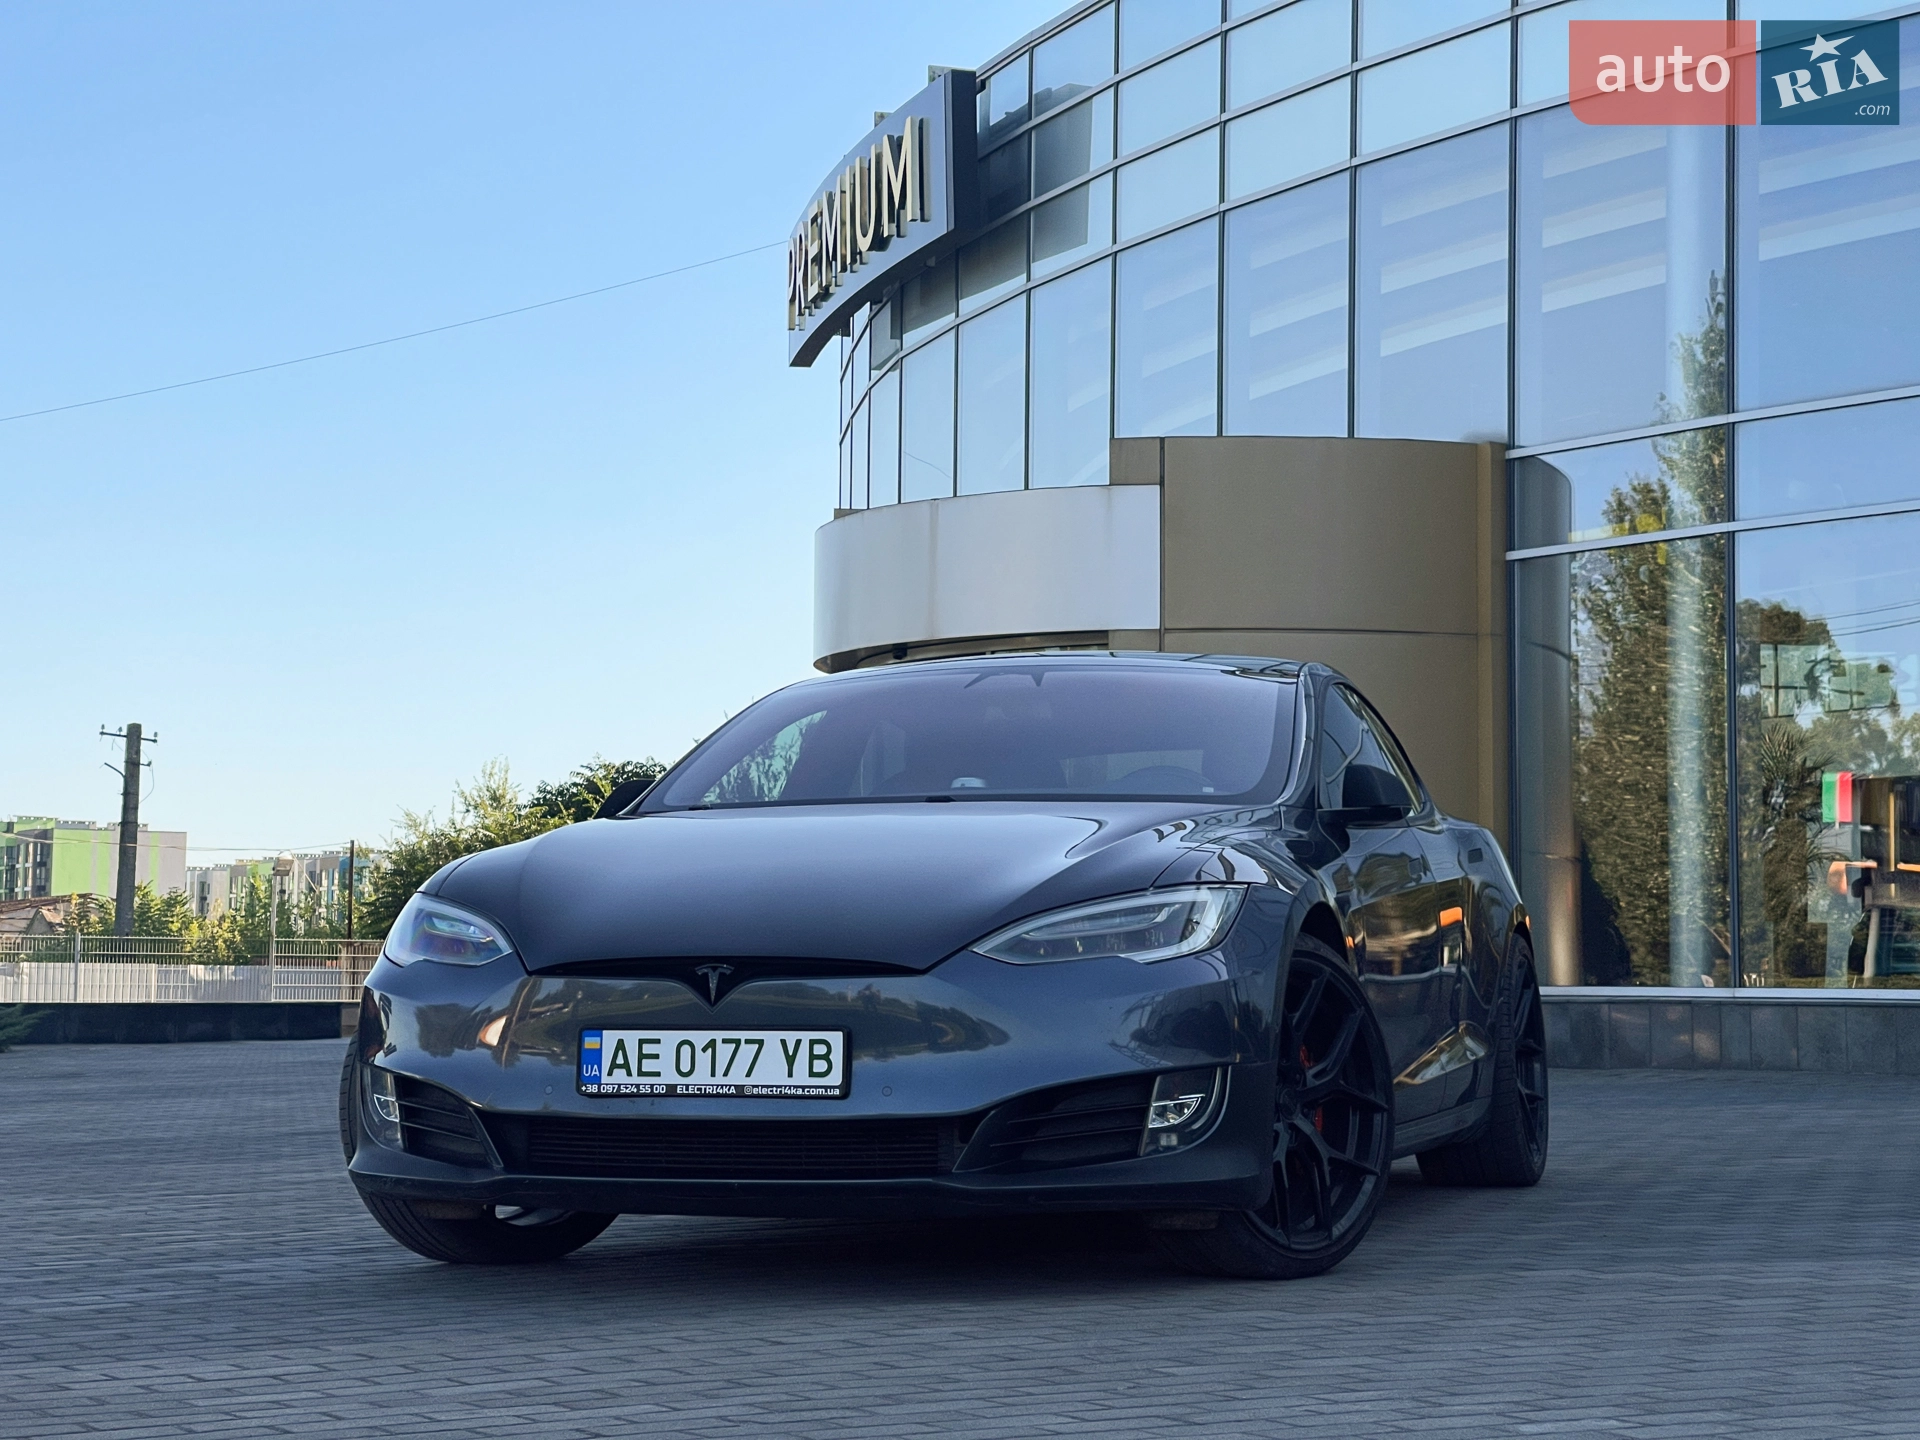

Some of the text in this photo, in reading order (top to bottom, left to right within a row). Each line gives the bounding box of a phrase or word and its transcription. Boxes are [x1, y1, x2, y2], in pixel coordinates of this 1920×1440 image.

[787, 115, 931, 330] PREMIUM
[606, 1038, 834, 1078] AE 0177 YB
[583, 1064, 600, 1077] UA
[581, 1084, 666, 1093] +38 097 524 55 00
[677, 1085, 736, 1094] ELECTRI4KA
